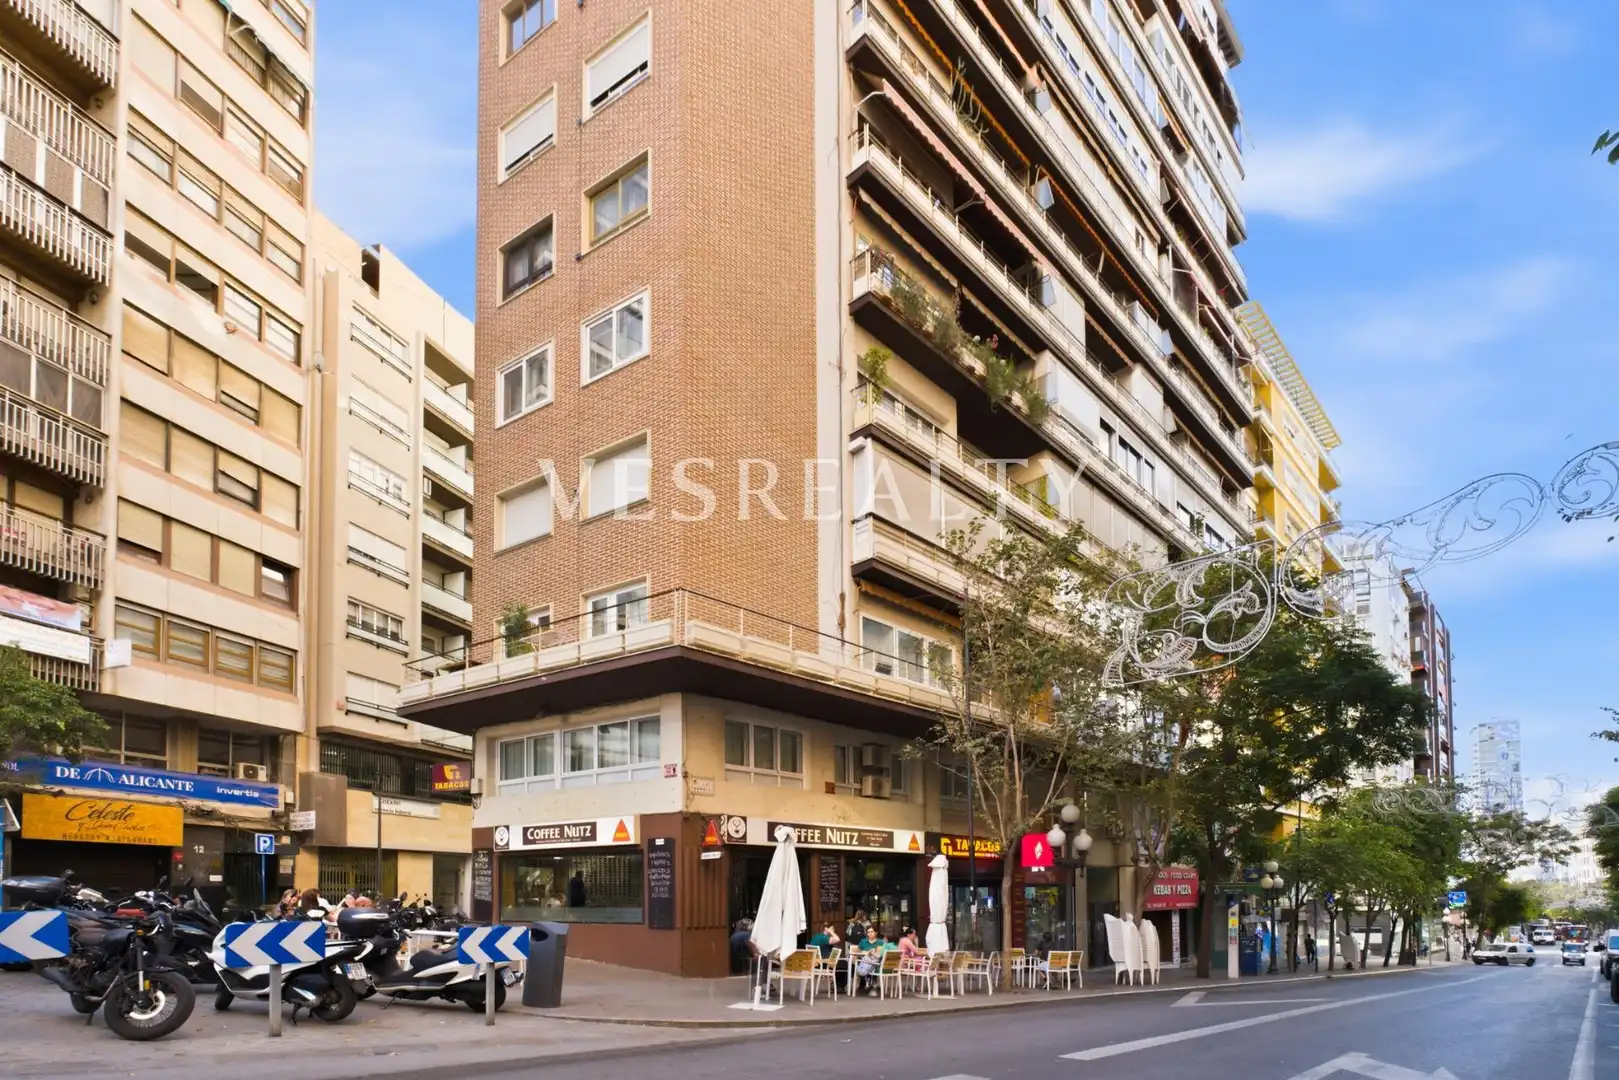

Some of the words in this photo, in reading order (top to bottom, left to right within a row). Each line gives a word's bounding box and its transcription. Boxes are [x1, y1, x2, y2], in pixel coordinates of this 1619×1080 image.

[55, 765, 81, 780] DE
[118, 773, 195, 792] ALICANTE
[434, 780, 470, 790] TABACOS
[216, 785, 260, 798] invertia
[65, 800, 136, 822] Celeste
[526, 827, 561, 840] COFFEE
[563, 824, 592, 839] NUTZ
[825, 827, 859, 846] NUTZ
[193, 845, 205, 854] 12
[259, 836, 271, 852] P
[955, 838, 1001, 852] TAACOS
[1153, 884, 1171, 896] KEBAB
[1177, 884, 1192, 895] PIZZA
